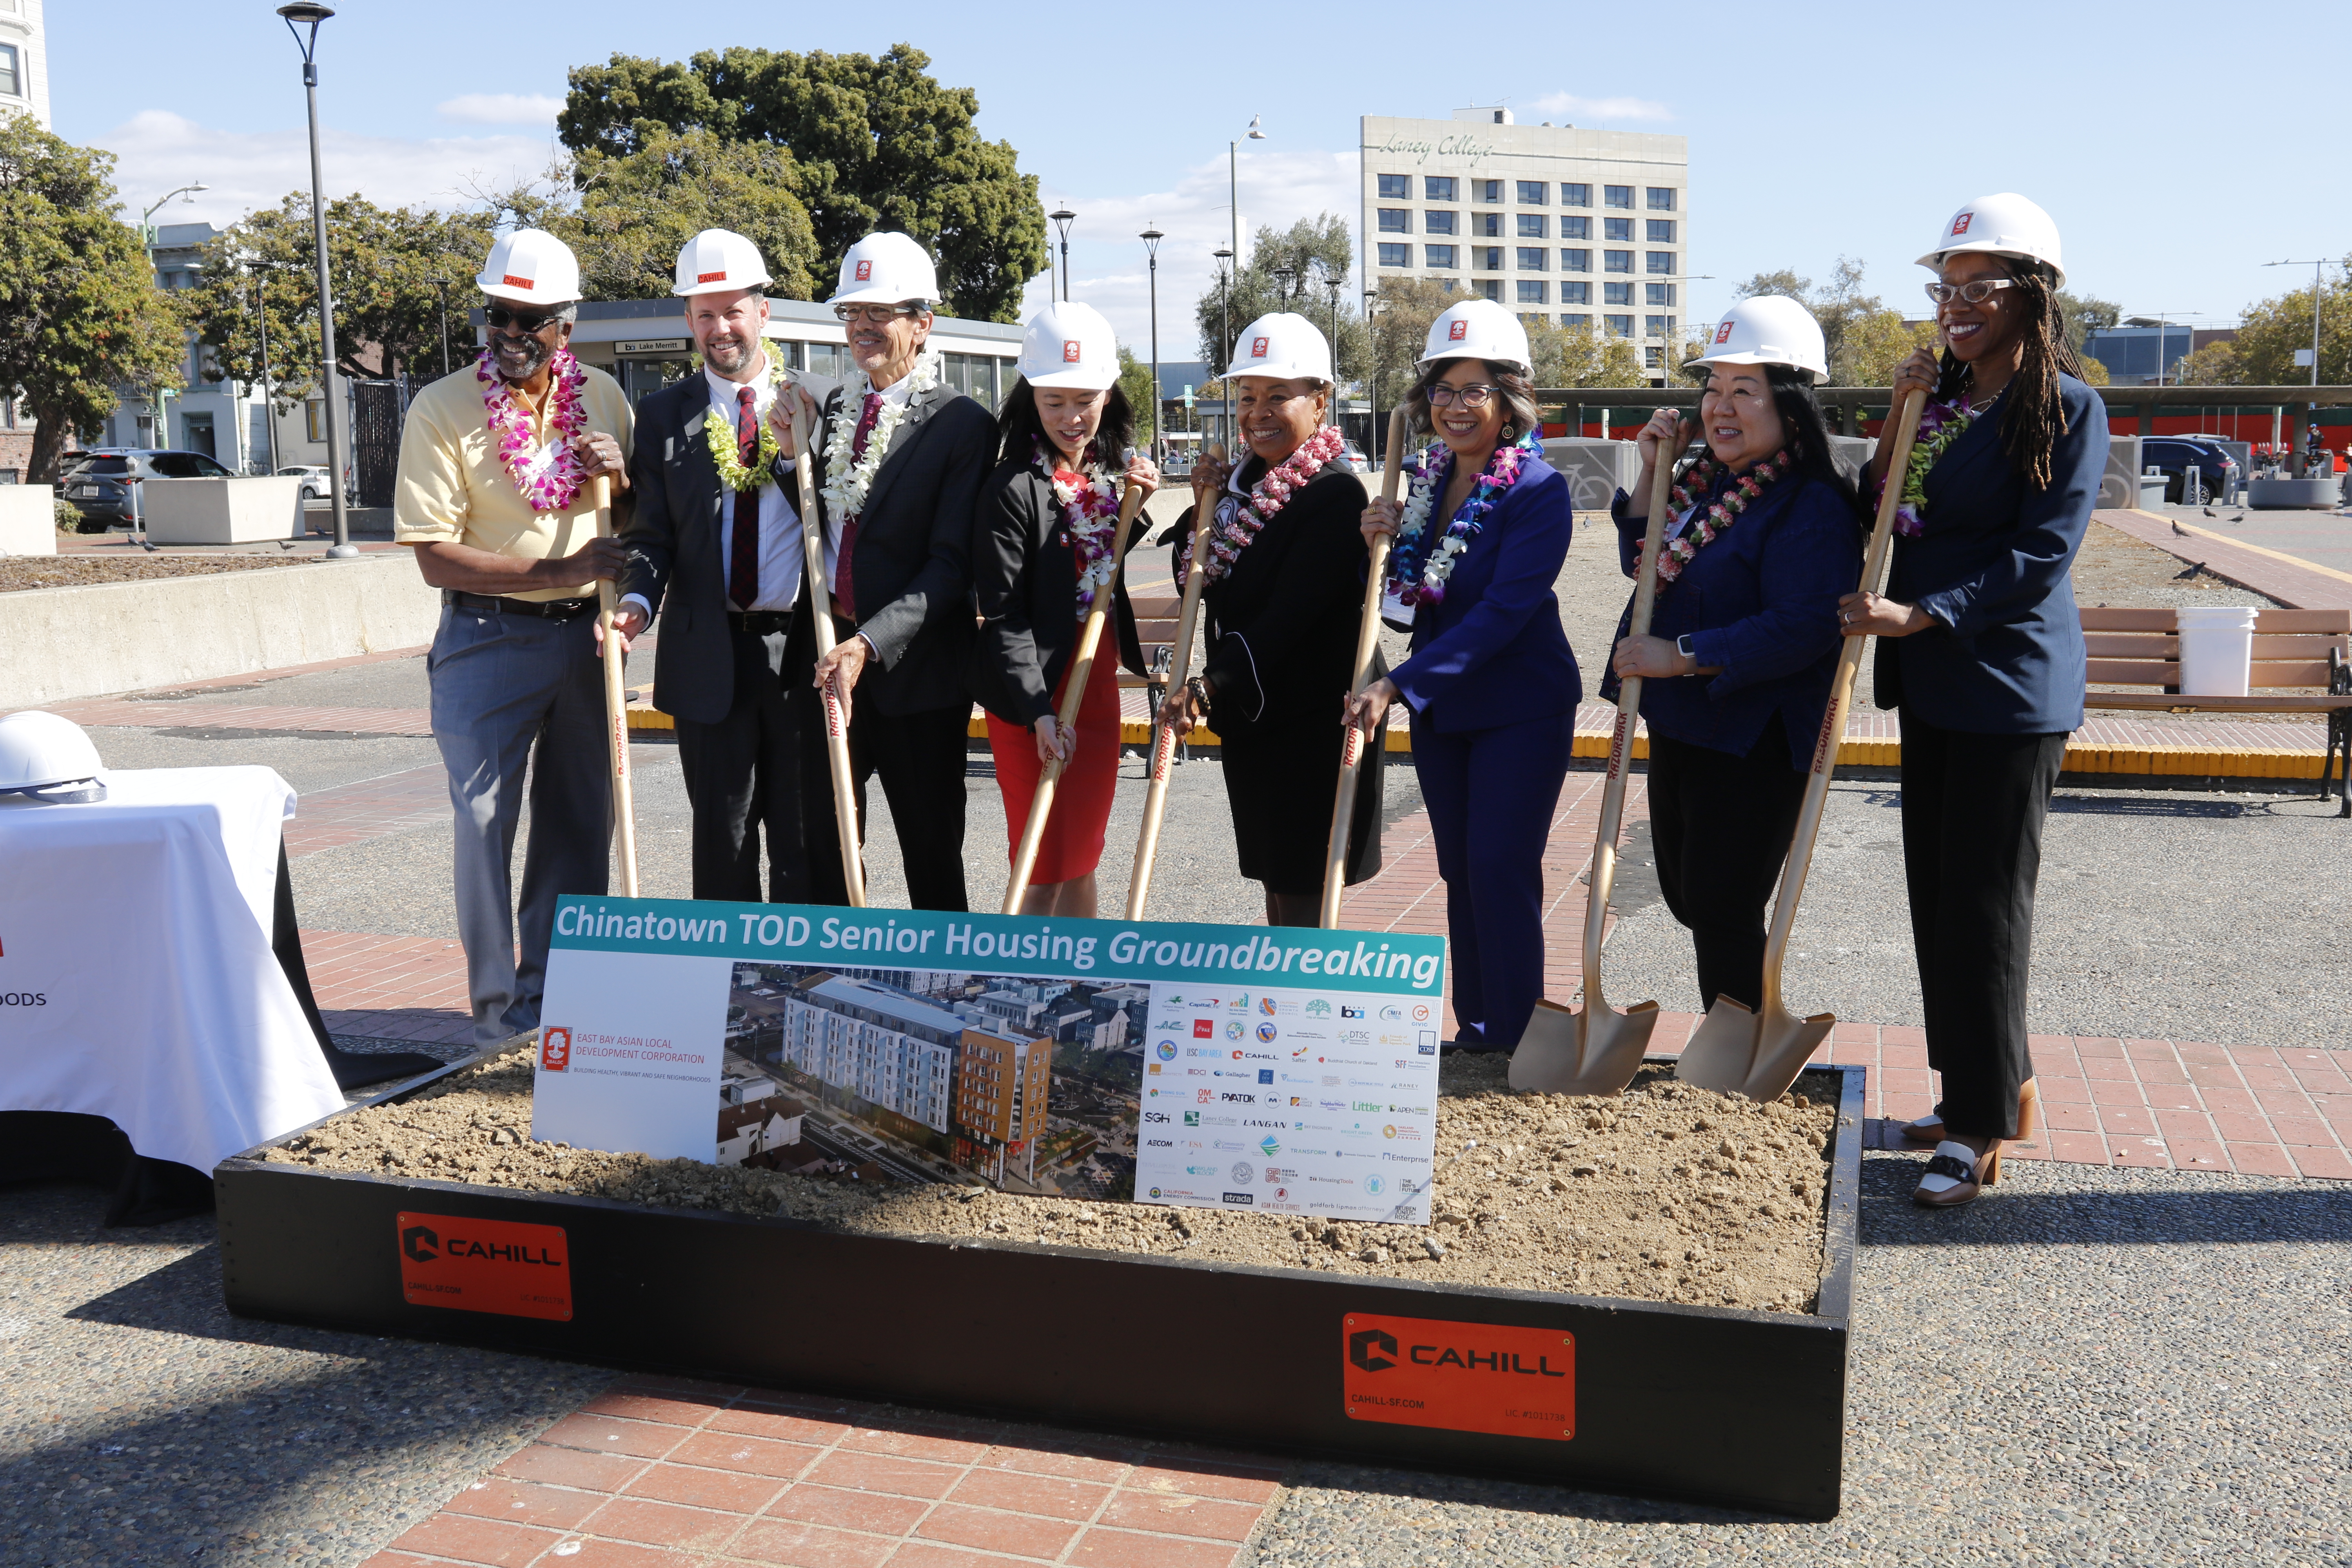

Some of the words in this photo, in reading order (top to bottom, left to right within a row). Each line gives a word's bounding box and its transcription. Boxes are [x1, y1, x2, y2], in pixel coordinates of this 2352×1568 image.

[1379, 131, 1433, 165] Laney
[1438, 134, 1492, 167] College
[504, 277, 533, 289] CAHILL
[698, 274, 726, 283] CAHILL
[1608, 709, 1628, 781] RAZORBACK
[557, 905, 727, 943] Chinatown
[739, 914, 810, 947] TOD
[820, 917, 935, 953] Senior
[945, 923, 1097, 969] Housing
[1109, 931, 1440, 989] Groundbreaking
[0, 993, 47, 1006] ODS
[1350, 1031, 1370, 1039] DTSC
[577, 1033, 597, 1043] EAST
[599, 1035, 615, 1044] BAY
[617, 1036, 642, 1046] ASIAN
[645, 1039, 672, 1049] LOCAL
[576, 1046, 639, 1059] DEVELOPMENT
[641, 1051, 704, 1064] CORPORATION
[1199, 1049, 1208, 1057] BAY
[1209, 1049, 1222, 1058] AREA
[1395, 1060, 1407, 1069] SFF
[666, 1074, 711, 1083] NEIGHBORHOODS
[1222, 1093, 1256, 1103] PYATOK
[1352, 1101, 1383, 1112] Littler
[1144, 1112, 1170, 1123] SGH
[1243, 1119, 1287, 1129] LANGAN
[1392, 1154, 1429, 1163] Enterprise
[1225, 1194, 1251, 1203] strada
[1358, 1204, 1385, 1212] attorneys
[447, 1239, 562, 1267] CAHILL
[408, 1281, 462, 1294] CAHILL-SF.COM
[533, 1295, 564, 1305] #1011738
[1411, 1345, 1566, 1377] CAHILL
[1351, 1394, 1425, 1409] CAHILL-SF.COM
[1505, 1409, 1520, 1418] LIC.
[1523, 1410, 1566, 1422] #1011738
